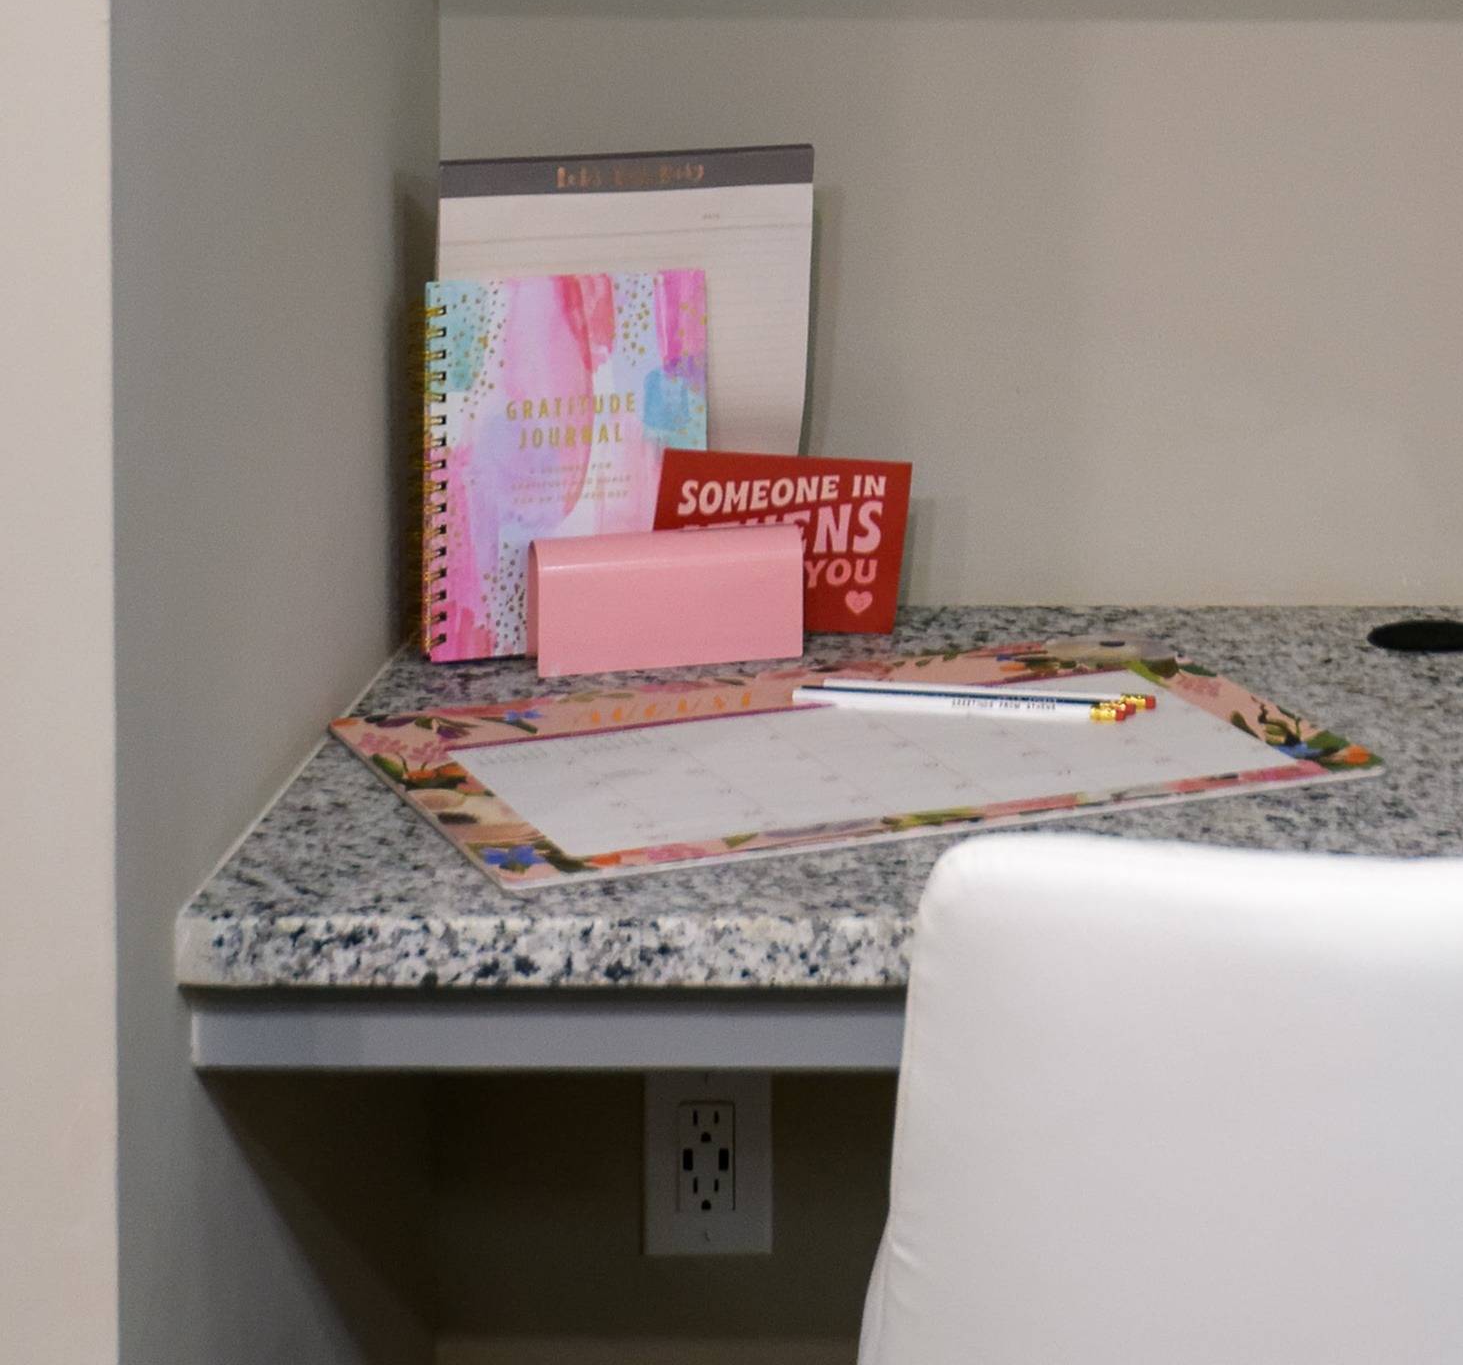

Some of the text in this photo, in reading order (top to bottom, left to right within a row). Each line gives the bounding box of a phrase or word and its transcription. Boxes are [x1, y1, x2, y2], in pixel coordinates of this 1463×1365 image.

[506, 391, 636, 421] GRATITUDE
[519, 422, 624, 451] JOURNAL
[677, 474, 887, 515] SOMEONE IN
[805, 558, 879, 589] YOU
